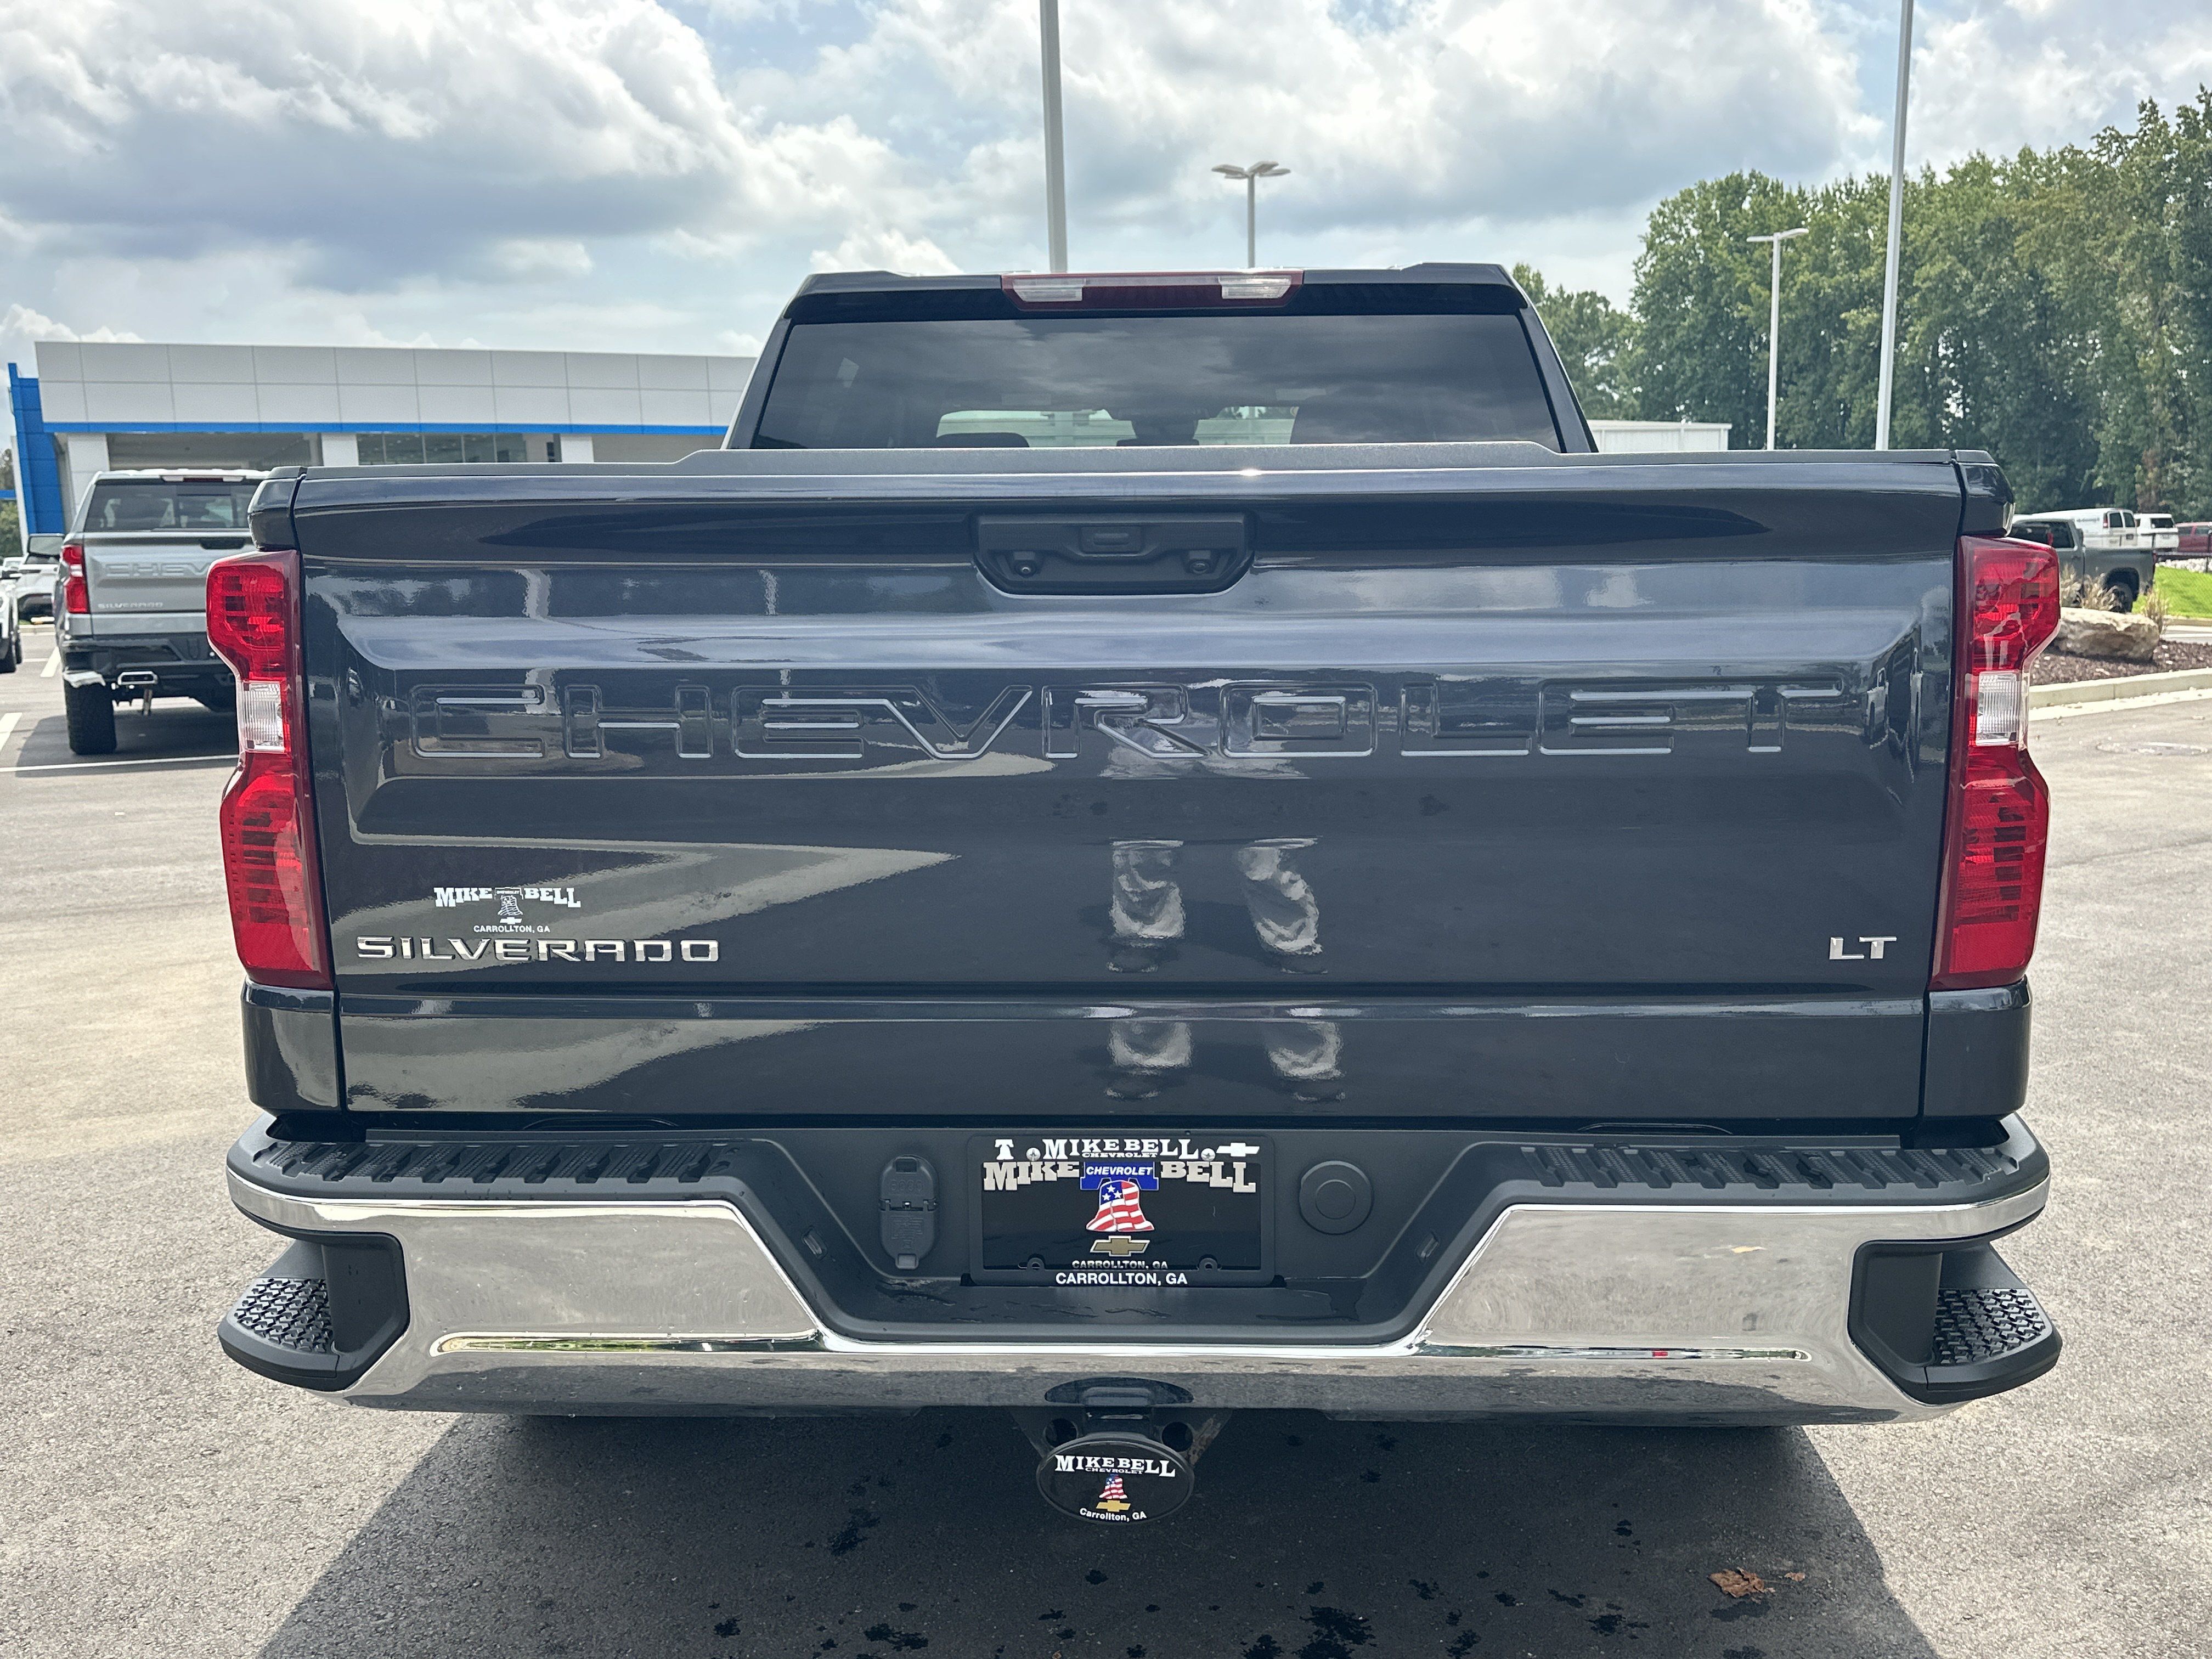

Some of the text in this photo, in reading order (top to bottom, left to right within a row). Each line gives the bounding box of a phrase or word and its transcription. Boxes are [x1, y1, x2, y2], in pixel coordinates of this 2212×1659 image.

[409, 676, 1844, 760] CHEVROLET
[434, 887, 581, 908] MIKE BELL
[356, 935, 720, 963] SILVERADO
[1829, 936, 1897, 960] LT
[1042, 1139, 1199, 1160] MIKE BELL
[983, 1161, 1256, 1193] MIKE BELL
[1086, 1166, 1153, 1175] CHEVROLET
[1056, 1273, 1188, 1286] CARROLLTON, GA
[1054, 1454, 1175, 1477] MIKE BELL
[1080, 1508, 1147, 1522] Carrollton, GA
